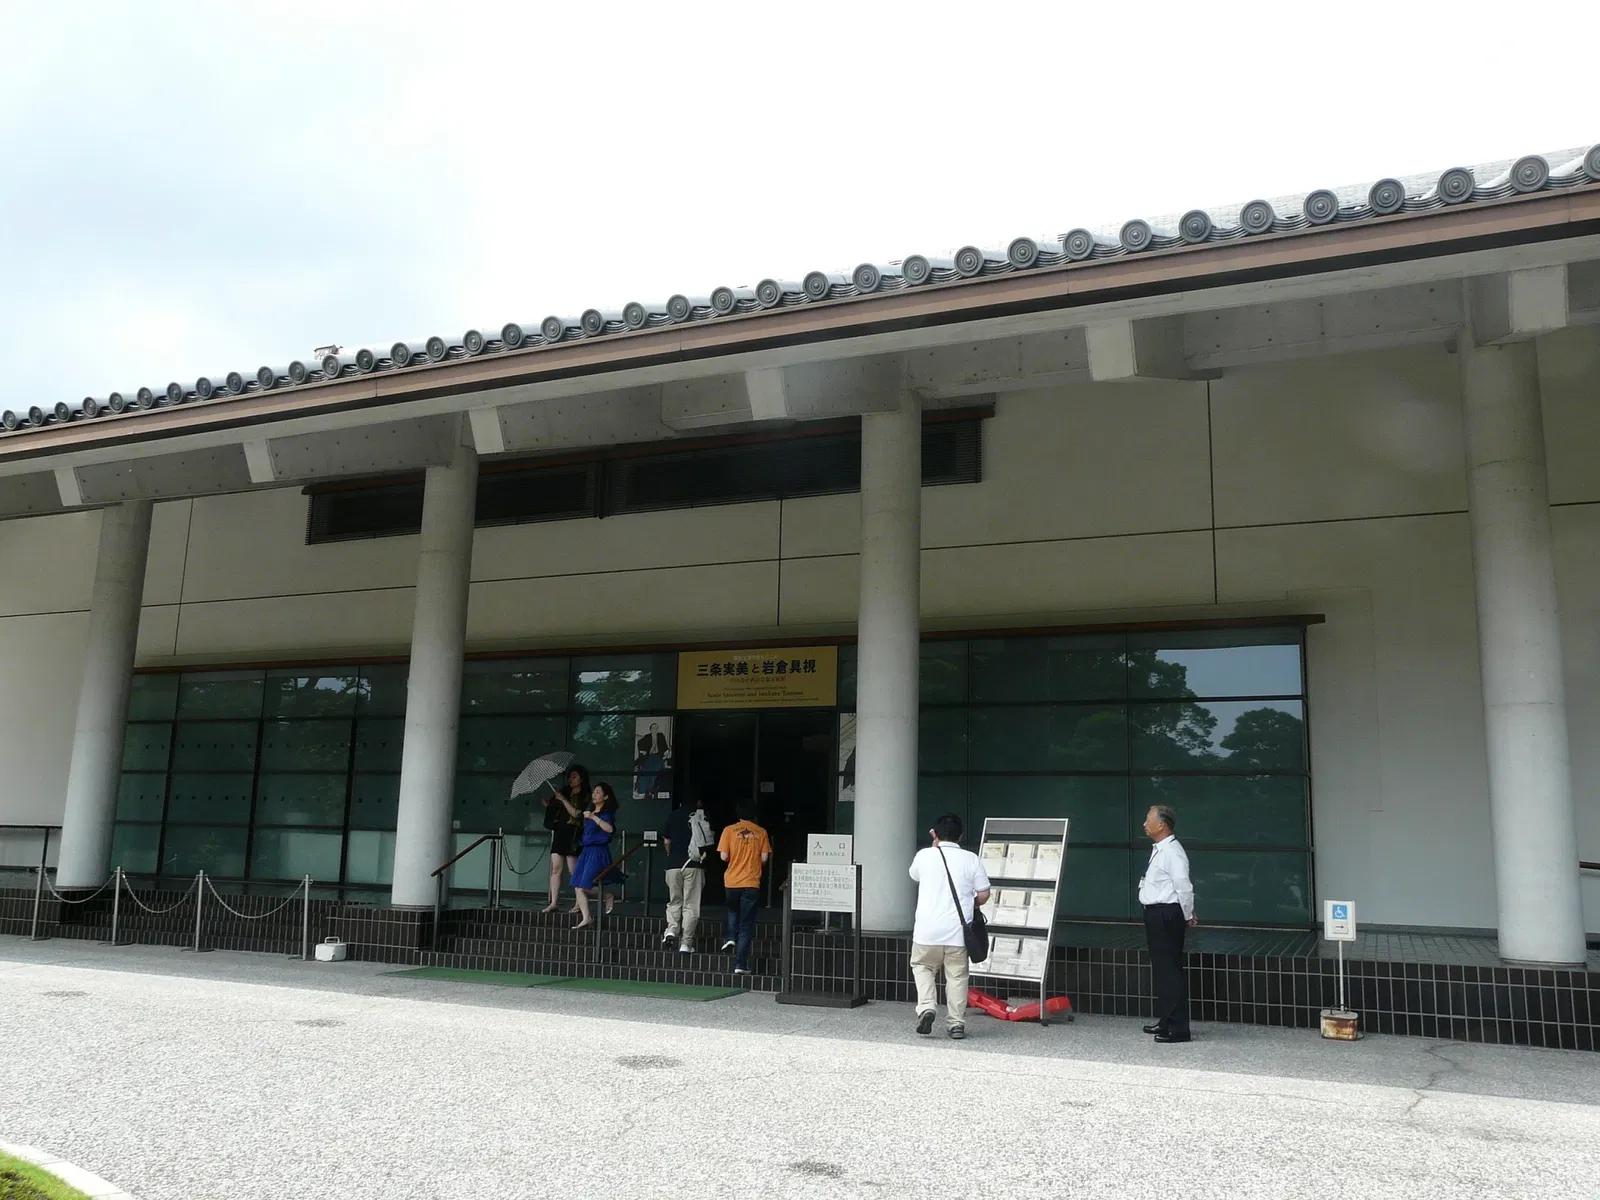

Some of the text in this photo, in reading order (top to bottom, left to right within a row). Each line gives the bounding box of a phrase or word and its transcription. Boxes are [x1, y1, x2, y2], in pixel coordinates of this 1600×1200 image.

[696, 659, 817, 677] 三条実美と岩倉具視
[814, 841, 846, 849] 入口
